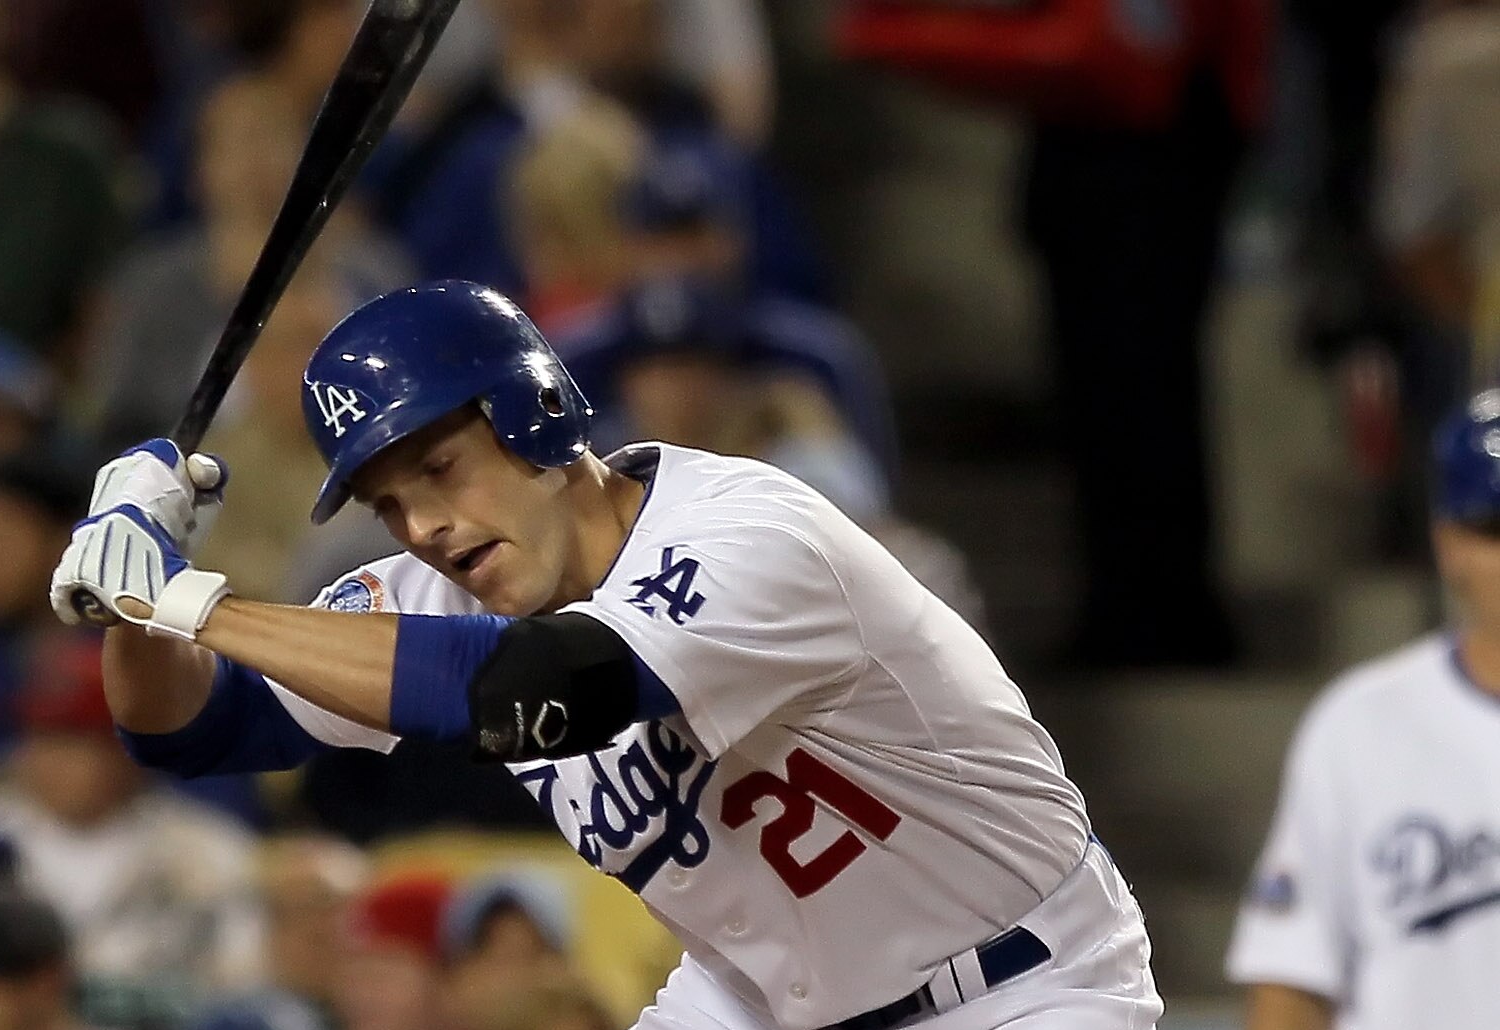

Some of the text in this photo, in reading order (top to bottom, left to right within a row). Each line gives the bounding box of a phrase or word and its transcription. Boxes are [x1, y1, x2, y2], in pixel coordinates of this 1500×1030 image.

[310, 381, 367, 438] LA
[622, 546, 707, 626] LA
[719, 746, 903, 899] 21
